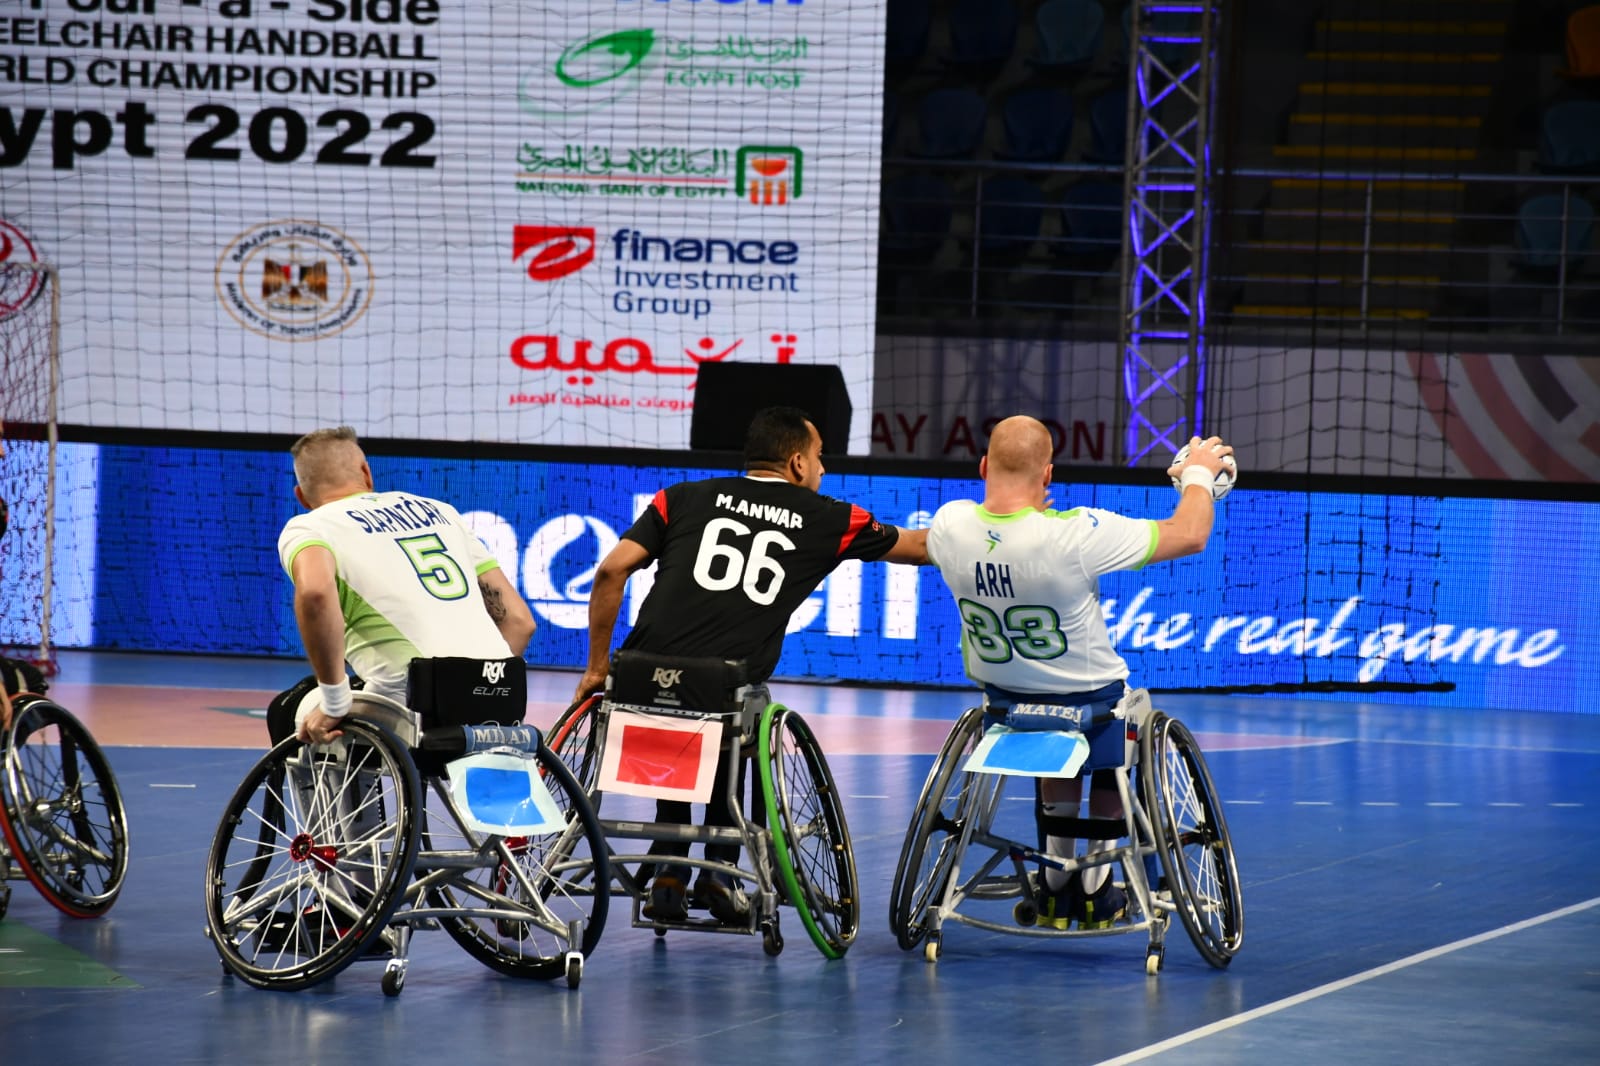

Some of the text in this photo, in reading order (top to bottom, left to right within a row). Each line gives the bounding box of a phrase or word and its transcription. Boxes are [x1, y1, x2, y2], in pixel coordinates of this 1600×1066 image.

[307, 0, 440, 25] Side
[206, 26, 439, 60] HANDBALL
[87, 59, 437, 98] CHAMPIONSHIP
[665, 71, 804, 90] EGYPT POST
[0, 102, 437, 170] ypt 2022
[514, 181, 728, 199] NATIONAL BANK OF EGYPT
[612, 228, 799, 266] finance
[613, 265, 800, 293] Investment
[613, 289, 712, 320] Group
[715, 493, 804, 529] M.ANWAR
[393, 532, 470, 602] 5
[693, 517, 797, 606] 66
[974, 560, 1016, 599] ARH
[958, 598, 1068, 664] 33
[1100, 587, 1566, 684] the real game
[472, 686, 512, 697] ELITE
[1012, 702, 1085, 724] MATEJ
[474, 727, 532, 746] MILAN
